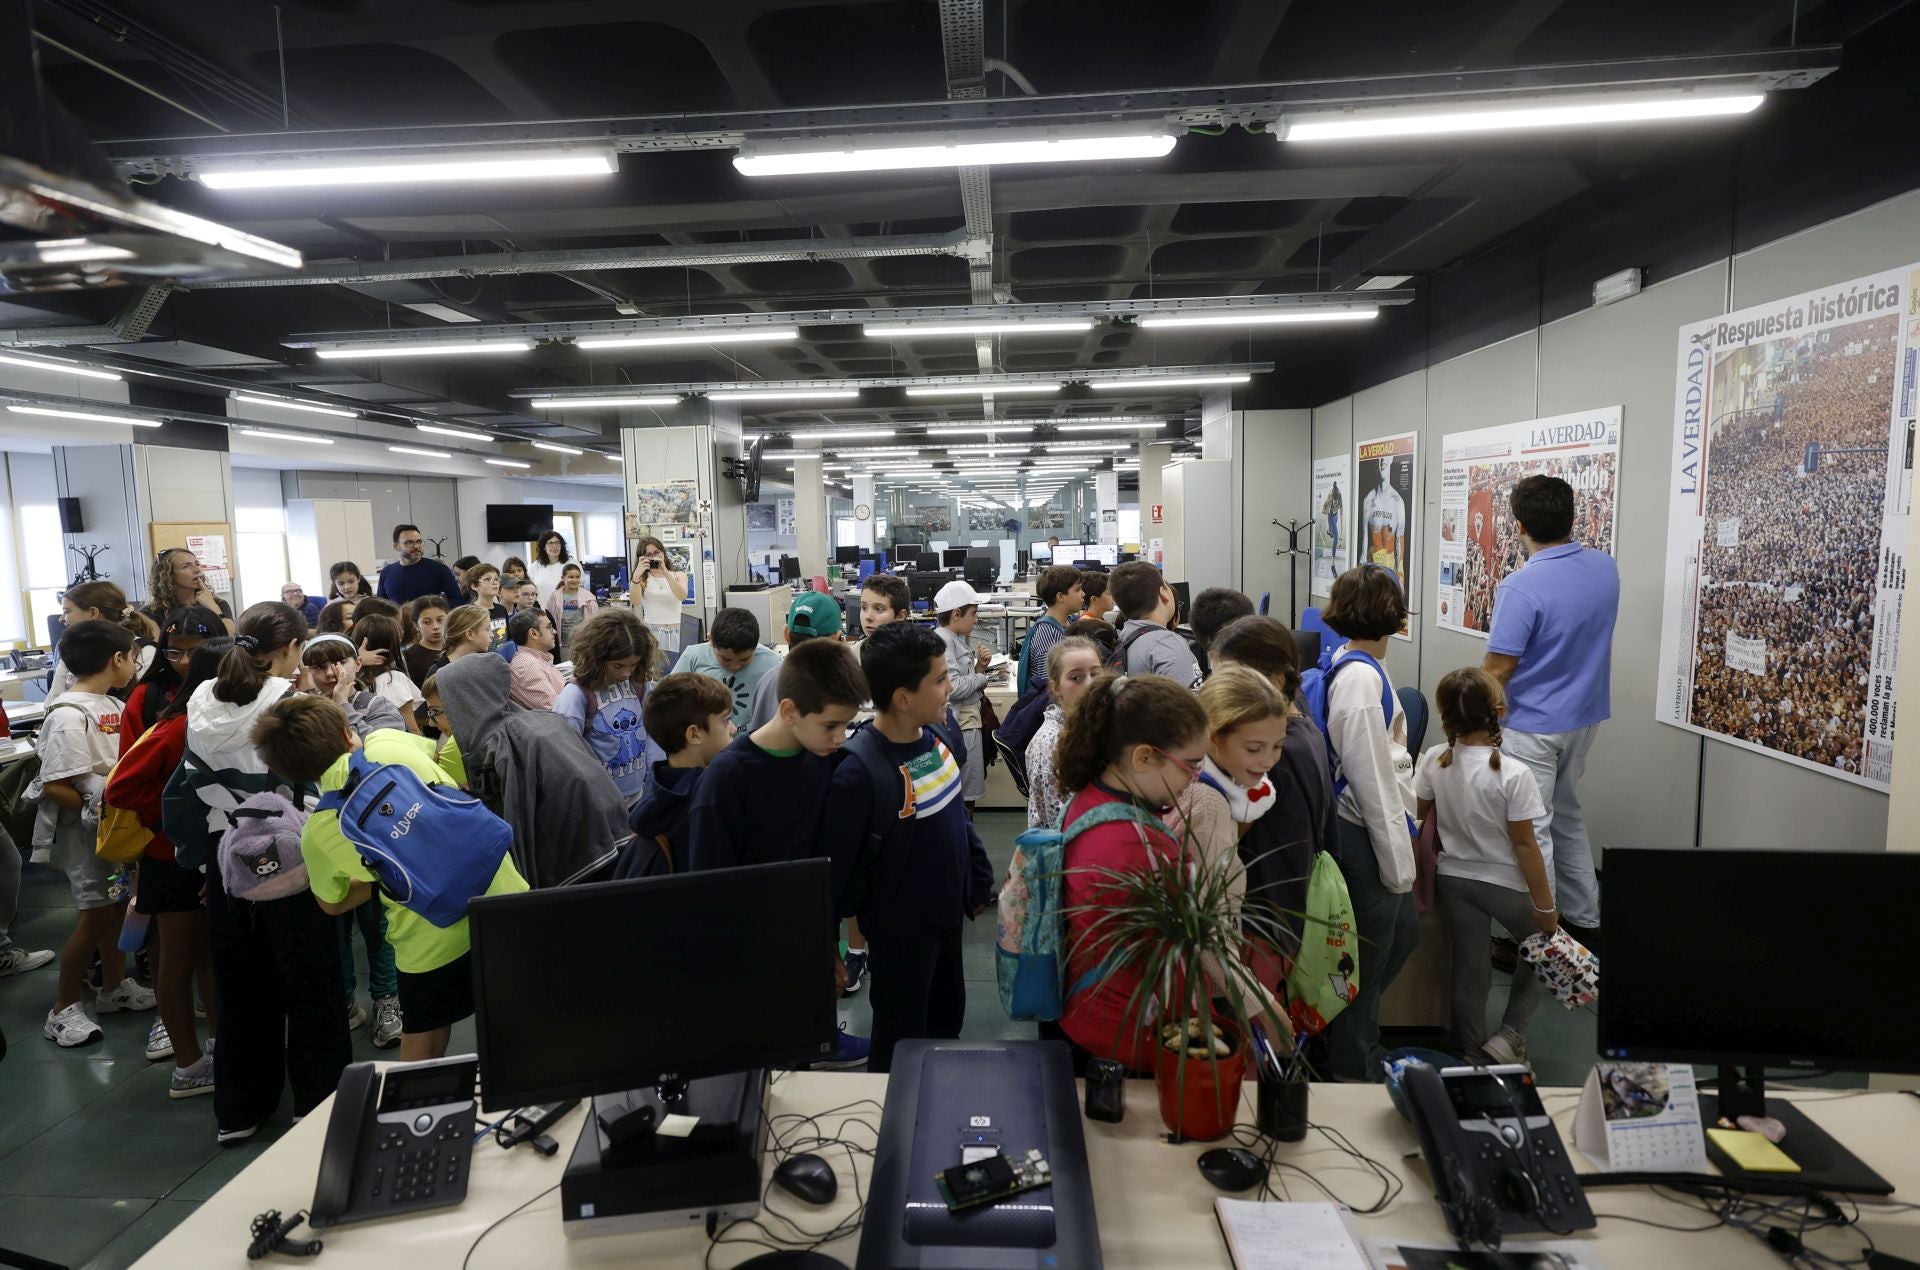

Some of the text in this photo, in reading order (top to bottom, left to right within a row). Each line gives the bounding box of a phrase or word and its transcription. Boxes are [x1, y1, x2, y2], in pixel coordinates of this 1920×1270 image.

[1717, 284, 1899, 346] Respuesta histórica
[1869, 674, 1882, 736] 400.000 voces
[1880, 676, 1893, 739] reclaman la paz
